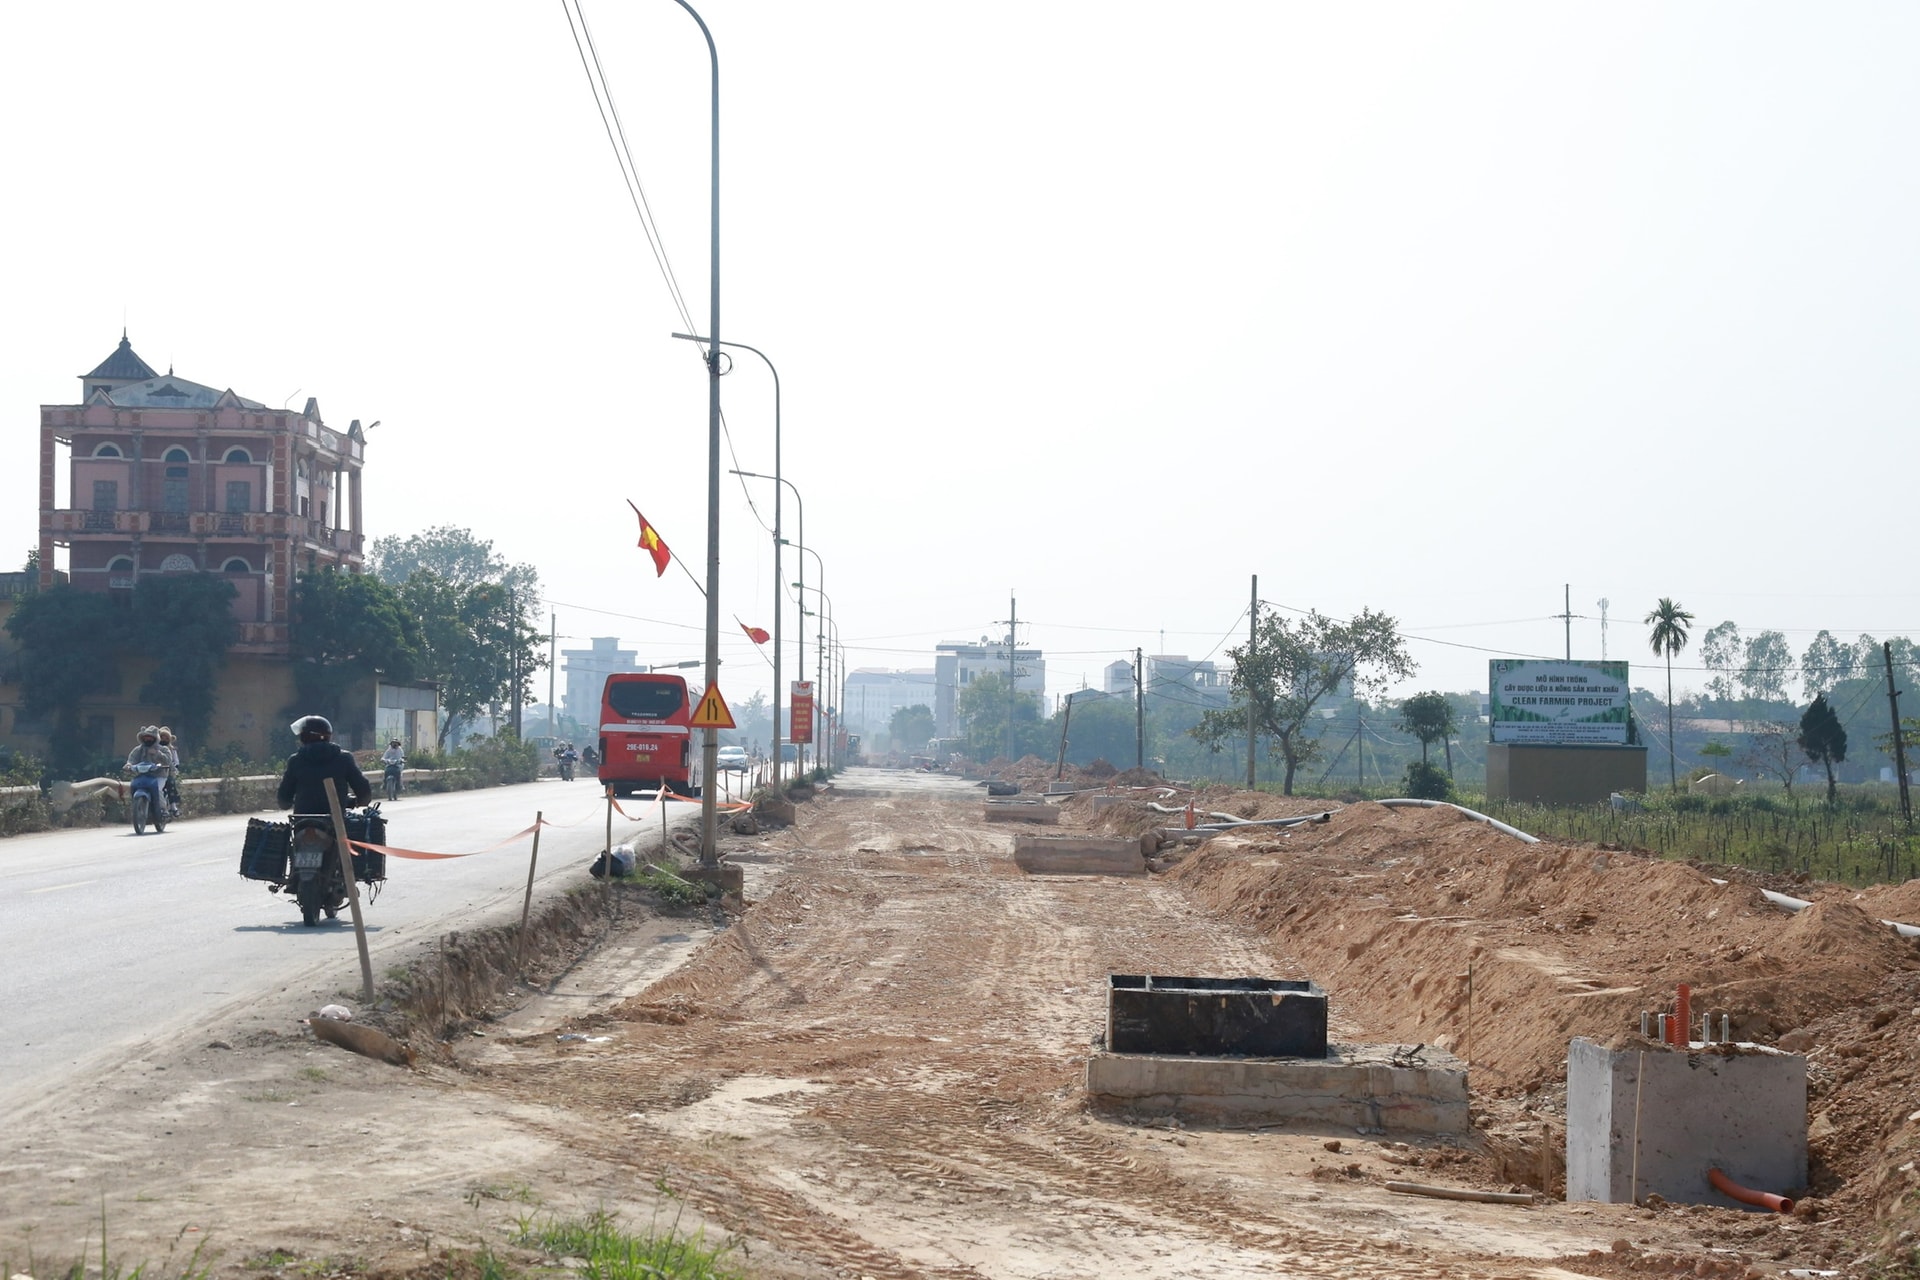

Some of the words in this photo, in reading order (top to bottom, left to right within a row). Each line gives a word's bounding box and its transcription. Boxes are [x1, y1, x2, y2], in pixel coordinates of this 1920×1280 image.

[1536, 674, 1547, 683] MÔ
[1549, 675, 1565, 683] HÌNH
[1512, 696, 1537, 705] CLEAN
[1539, 697, 1576, 706] FARMING
[1578, 697, 1613, 706] PROJECT
